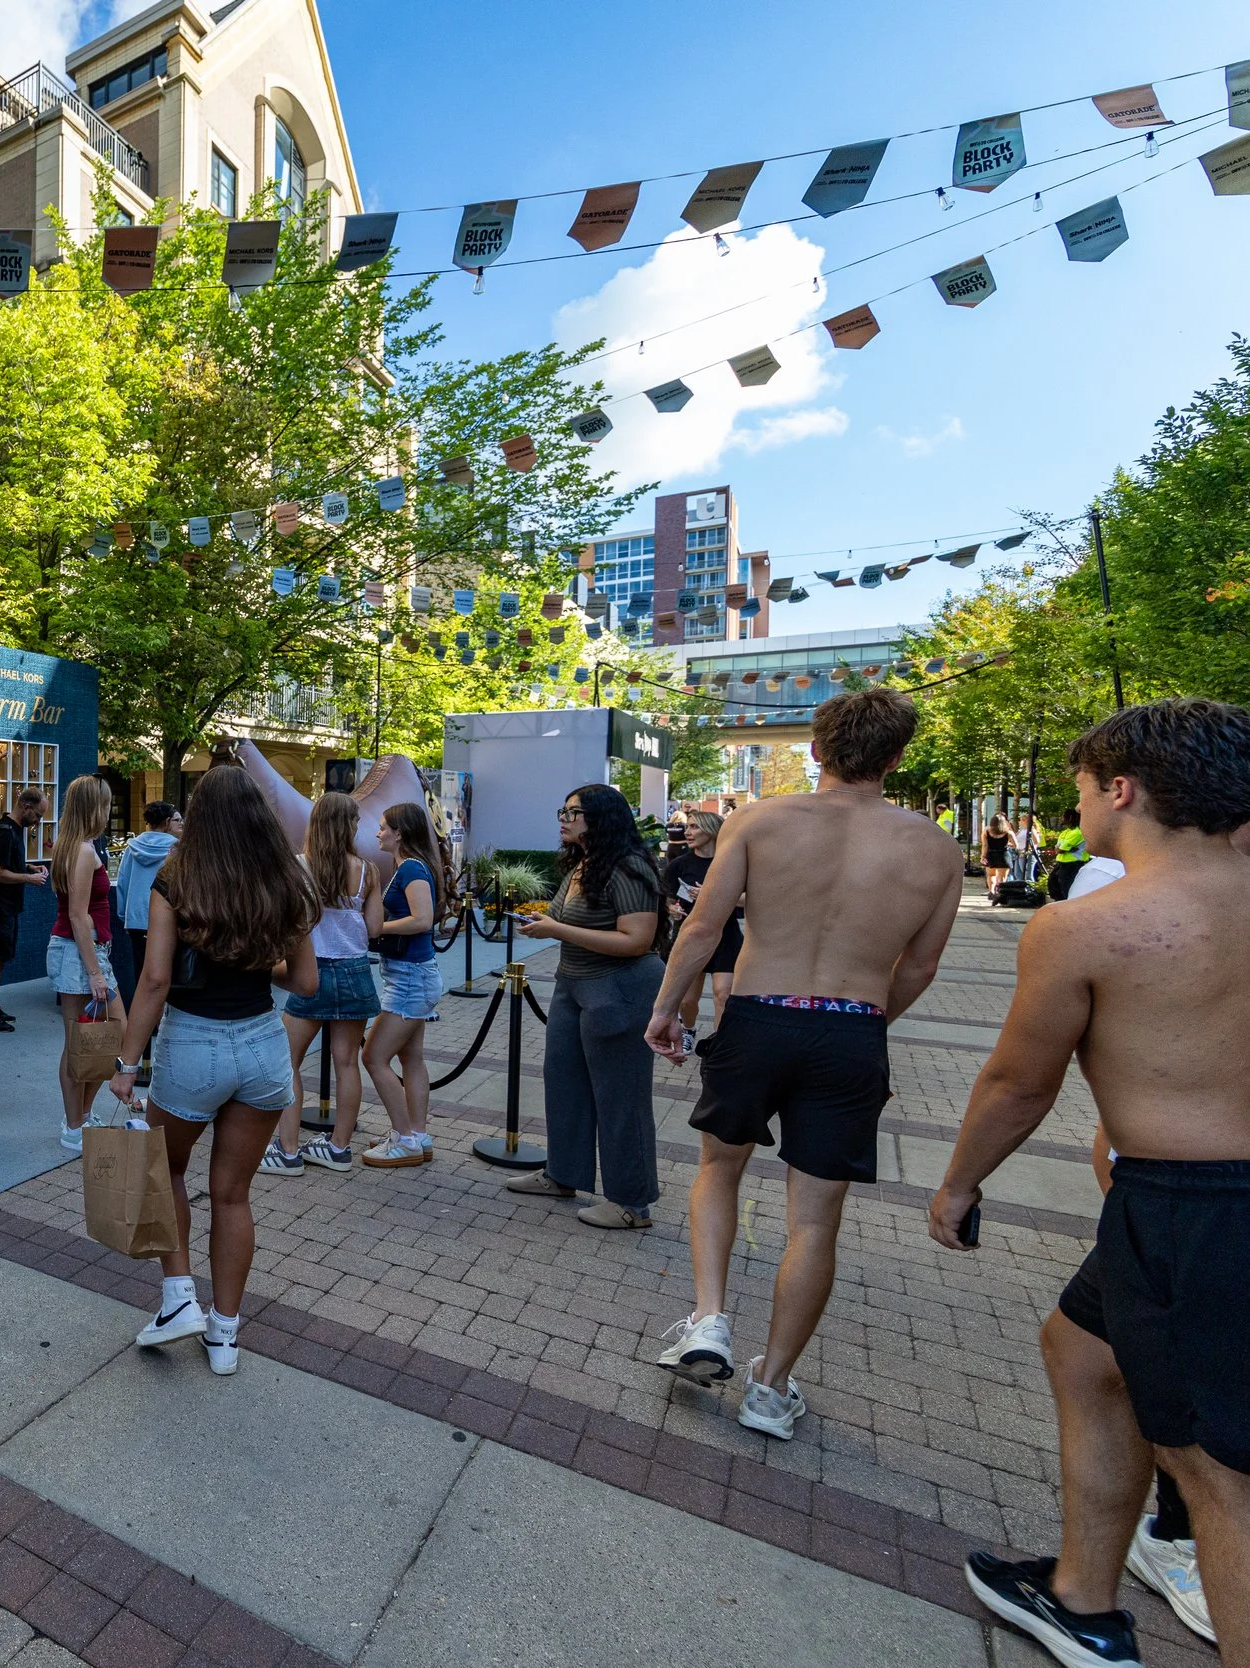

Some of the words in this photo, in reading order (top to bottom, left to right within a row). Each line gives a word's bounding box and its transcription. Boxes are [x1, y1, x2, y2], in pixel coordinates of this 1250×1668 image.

[1107, 106, 1155, 119] GATORADE
[963, 141, 1011, 165] BLOCK
[962, 152, 1014, 178] PARTY
[1211, 156, 1248, 173] MICHAEL
[823, 168, 847, 176] Shark
[464, 228, 504, 243] BLOCK
[1069, 225, 1093, 238] Shark
[108, 250, 151, 258] GATORADE
[461, 242, 502, 256] PARTY
[946, 272, 983, 293] BLOCK
[950, 280, 988, 299] PARTY
[327, 503, 345, 512] BLOCK
[327, 510, 345, 518] PARTY
[24, 672, 44, 685] KORS
[30, 695, 66, 725] Bar
